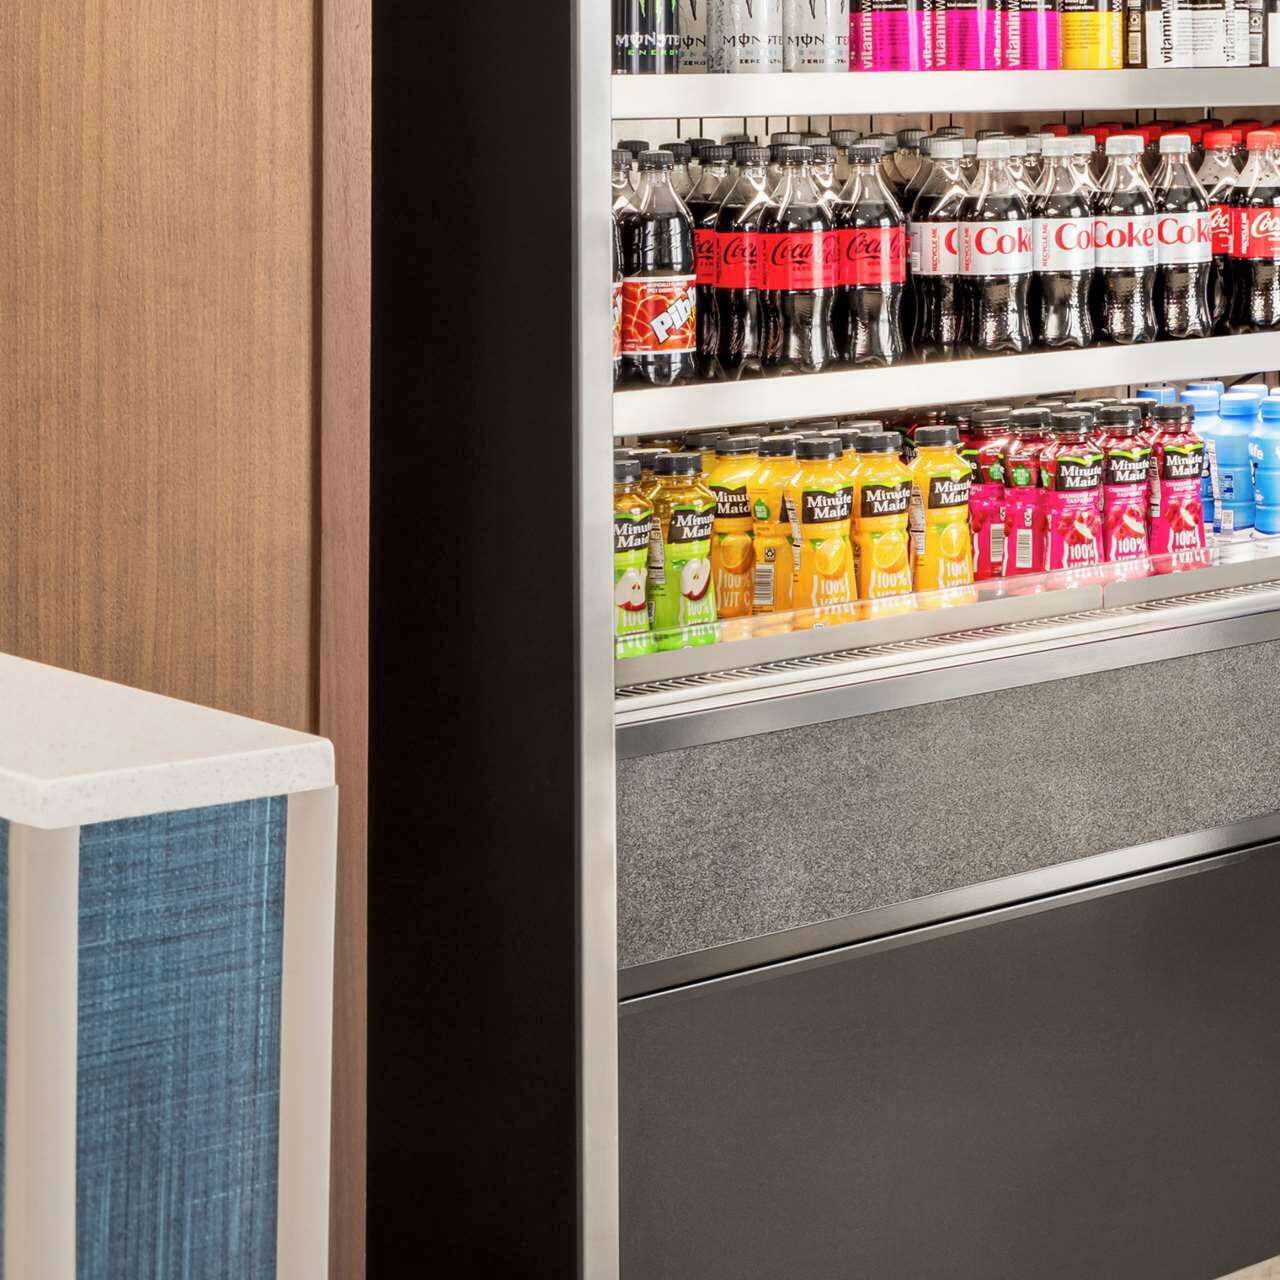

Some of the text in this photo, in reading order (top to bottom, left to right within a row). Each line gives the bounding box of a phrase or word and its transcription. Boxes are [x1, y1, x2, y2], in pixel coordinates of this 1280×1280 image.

[615, 31, 680, 48] MONSTE
[1094, 220, 1154, 248] Coke
[1111, 458, 1150, 472] Minute
[1166, 452, 1202, 467] Minute
[1060, 464, 1102, 478] Minute
[1115, 468, 1146, 482] Maid
[1171, 464, 1200, 477] Maid
[1065, 474, 1098, 489] Maid
[806, 492, 852, 509] Minute
[866, 485, 911, 503] Minute
[940, 490, 969, 505] Maid
[813, 504, 848, 520] Maid
[873, 499, 907, 514] Maid
[682, 523, 712, 539] Maid
[1117, 536, 1146, 553] 100%
[877, 571, 907, 587] 100%
